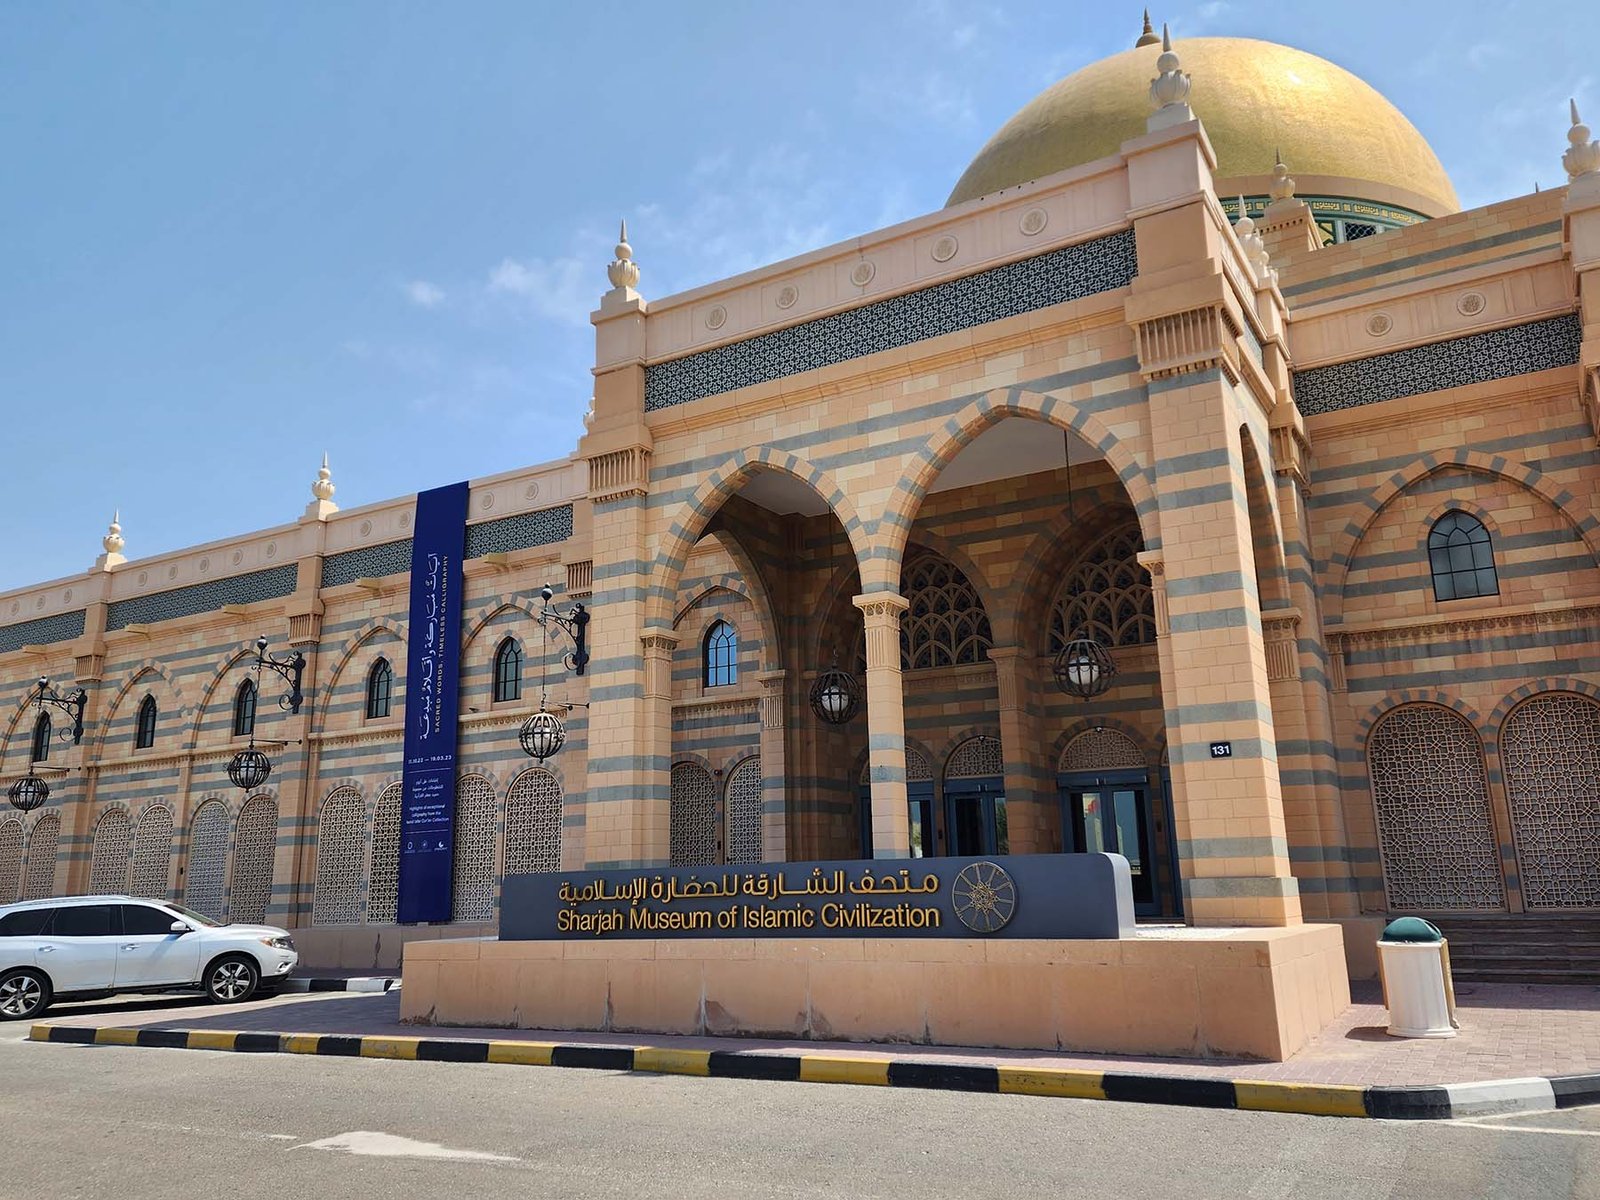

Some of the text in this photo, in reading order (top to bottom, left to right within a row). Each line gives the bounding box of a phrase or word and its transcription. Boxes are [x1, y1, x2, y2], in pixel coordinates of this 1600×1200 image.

[440, 555, 448, 613] CALLIGRAPHY
[438, 615, 446, 658] TIMELESS
[436, 660, 444, 694] WORDS,
[1212, 745, 1230, 755] 131
[558, 867, 939, 906] متحف الشارقة للحضارة الإسلامية
[557, 903, 940, 935] Sharjah Museum of Islamic Civilization
